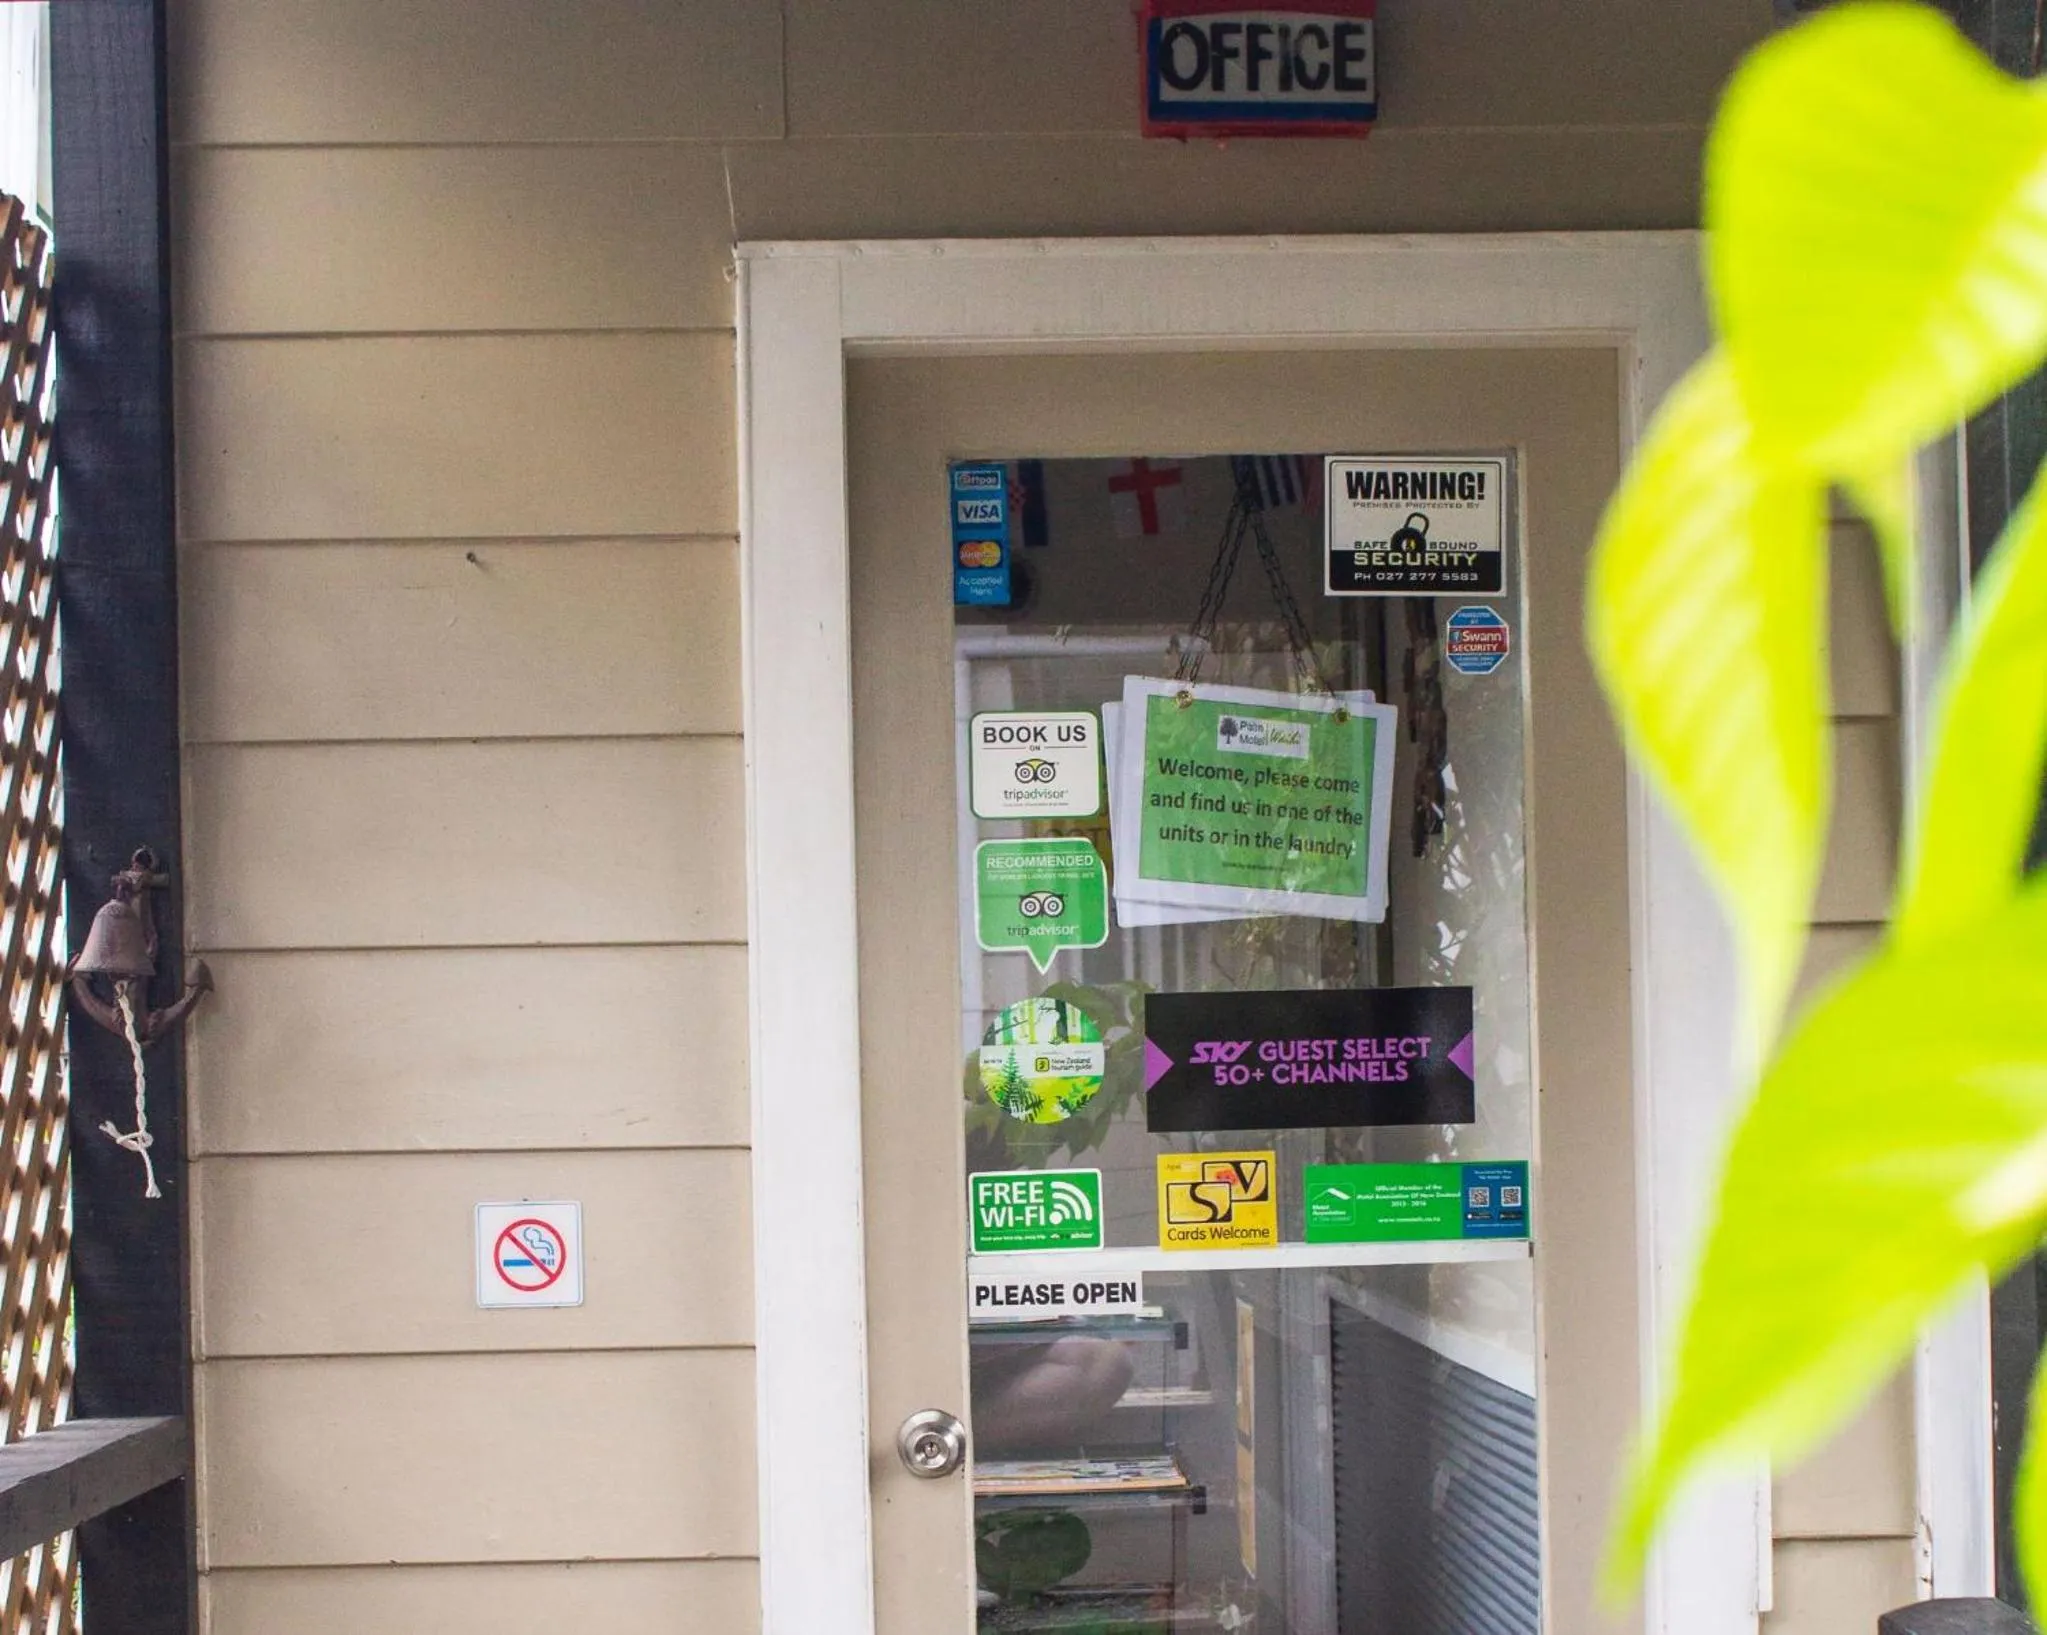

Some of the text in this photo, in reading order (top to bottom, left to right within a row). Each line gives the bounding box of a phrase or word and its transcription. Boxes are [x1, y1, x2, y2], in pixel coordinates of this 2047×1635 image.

[1159, 22, 1367, 92] OFFICE
[1345, 471, 1486, 501] WARNING!
[962, 505, 999, 519] VISA
[1354, 541, 1388, 550] SAFE
[1353, 552, 1477, 567] SECURITY
[1376, 572, 1404, 581] 027
[1409, 572, 1437, 581] 277
[1442, 572, 1479, 581] 5583
[1462, 630, 1502, 642] Swann
[1452, 643, 1499, 652] SECURITY
[983, 725, 1086, 743] BOOK US
[1158, 757, 1360, 794] Welcome, please come
[1003, 788, 1065, 803] tripadvisor
[1151, 790, 1363, 826] and find us in one of the
[1159, 823, 1204, 843] units
[1209, 831, 1226, 845] or
[1234, 828, 1249, 848] in
[1254, 831, 1283, 850] the
[986, 854, 1094, 869] RECOMMENDED
[1007, 922, 1076, 938] tripadvisor
[1189, 1037, 1431, 1064] SKY GUEST SELECT
[1214, 1060, 1409, 1086] 50+ CHANNELS
[978, 1181, 1045, 1206] FREE
[980, 1205, 1046, 1229] WI-FI
[1167, 1225, 1270, 1241] Cards Welcome
[975, 1282, 1137, 1307] PLEASE OPEN
